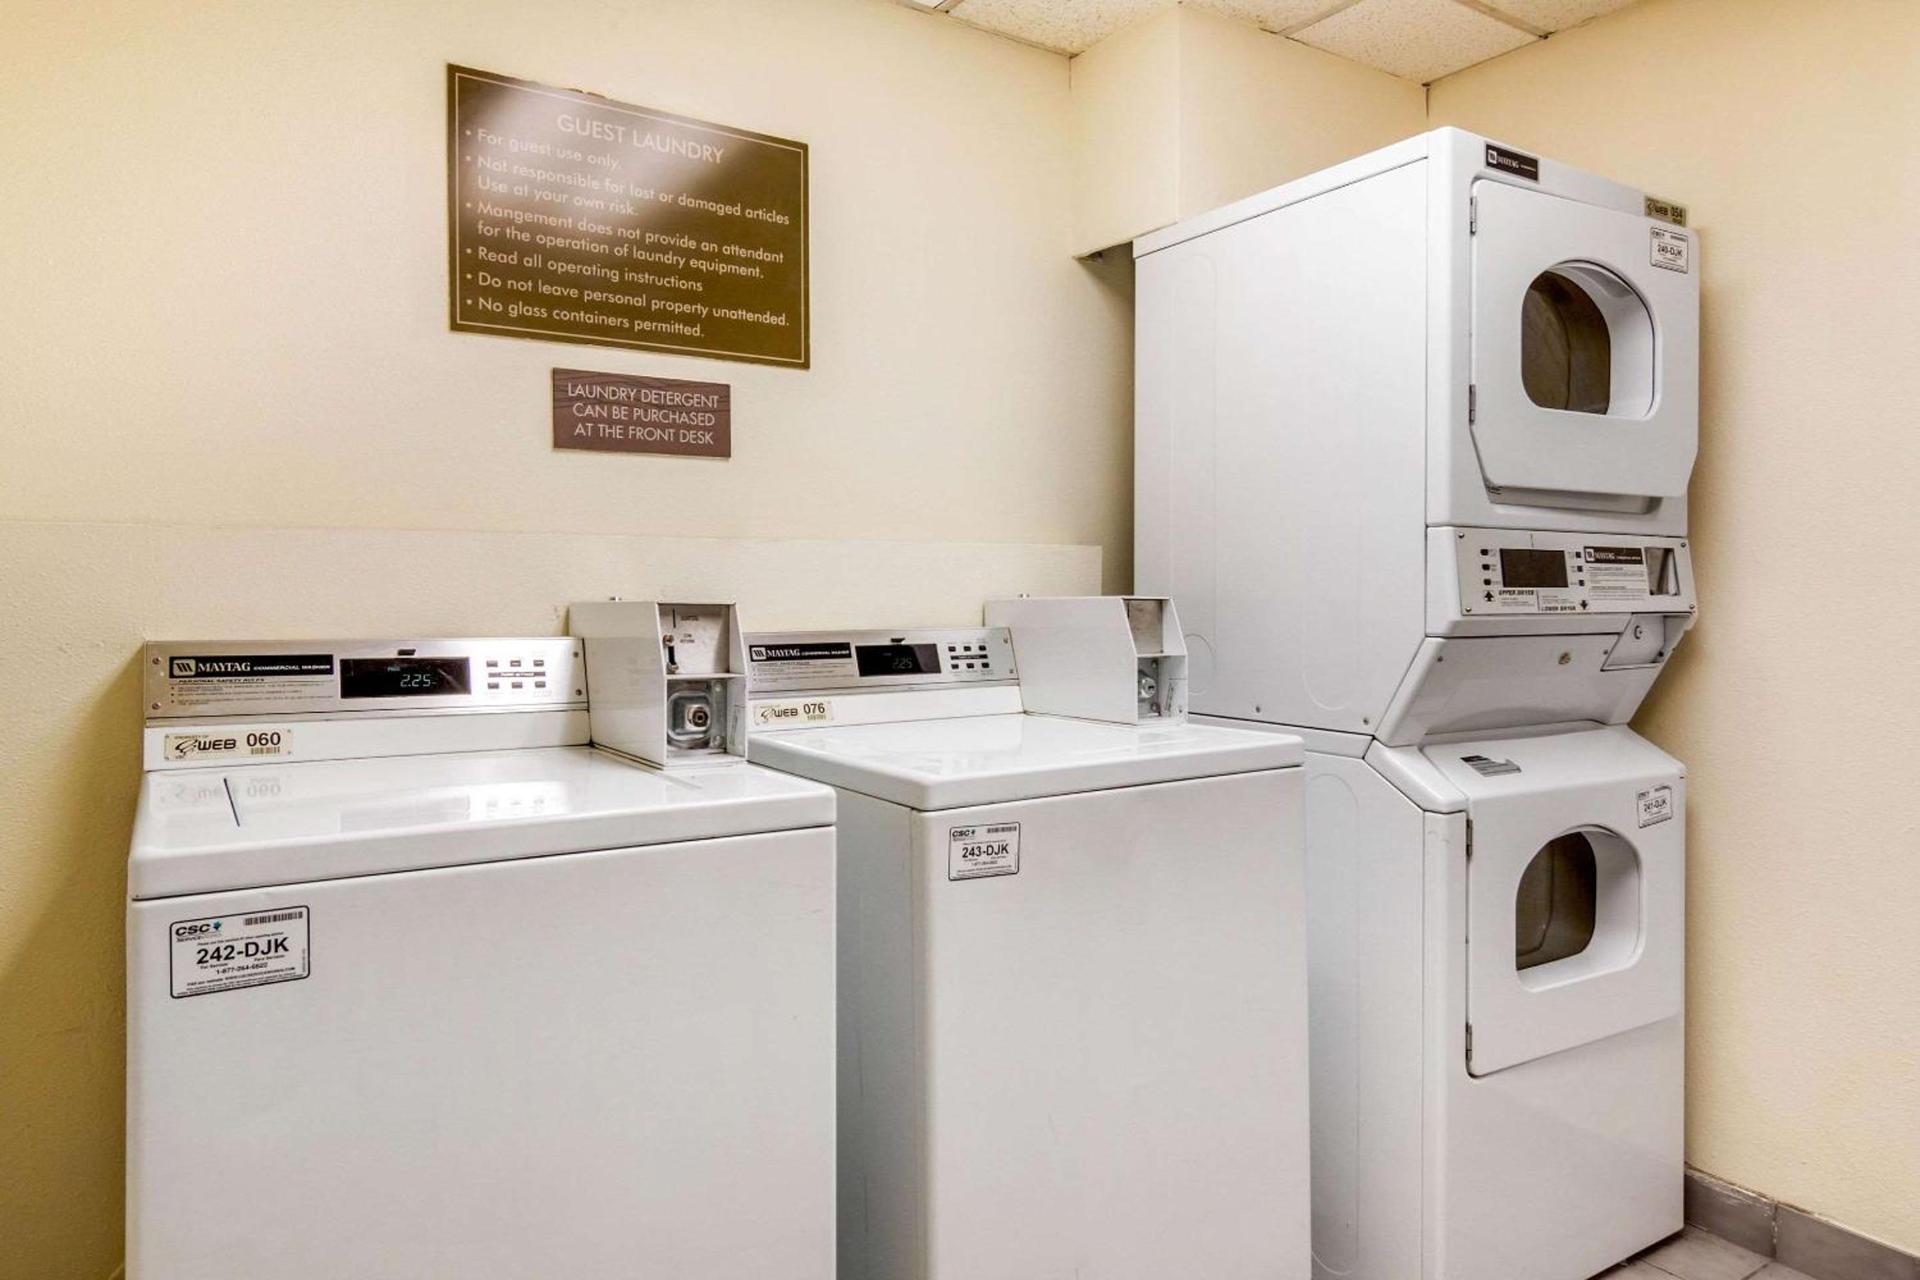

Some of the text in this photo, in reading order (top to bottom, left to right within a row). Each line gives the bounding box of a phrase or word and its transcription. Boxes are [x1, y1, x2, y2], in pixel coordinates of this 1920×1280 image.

[477, 128, 622, 170] For guest use only.
[557, 114, 724, 164] GUEST LAUNDRY
[477, 155, 790, 225] Not responsible for lost or damaged articles
[477, 175, 639, 217] Use at your own risk.
[477, 202, 784, 263] Mangement does not provide an attendant
[477, 220, 764, 279] for the operation of laundry equipment.
[478, 246, 703, 292] Read all operating instructions
[478, 271, 790, 327] Do not leave personal property unattended.
[478, 297, 705, 338] No glass containers permitted.
[567, 382, 719, 409] LAUNDRY DETERGENT
[573, 402, 715, 427] CAN BE PURCHASED
[574, 422, 714, 445] AT THE FRONT DESK
[198, 661, 251, 673] MAYTAG
[767, 648, 800, 658] MAYTAG
[400, 673, 432, 688] 2.25
[803, 702, 826, 715] 076
[197, 732, 281, 751] WEB 060
[961, 843, 1009, 859] 243-DJK
[175, 923, 211, 937] CSC
[196, 936, 290, 965] 242-DJK
